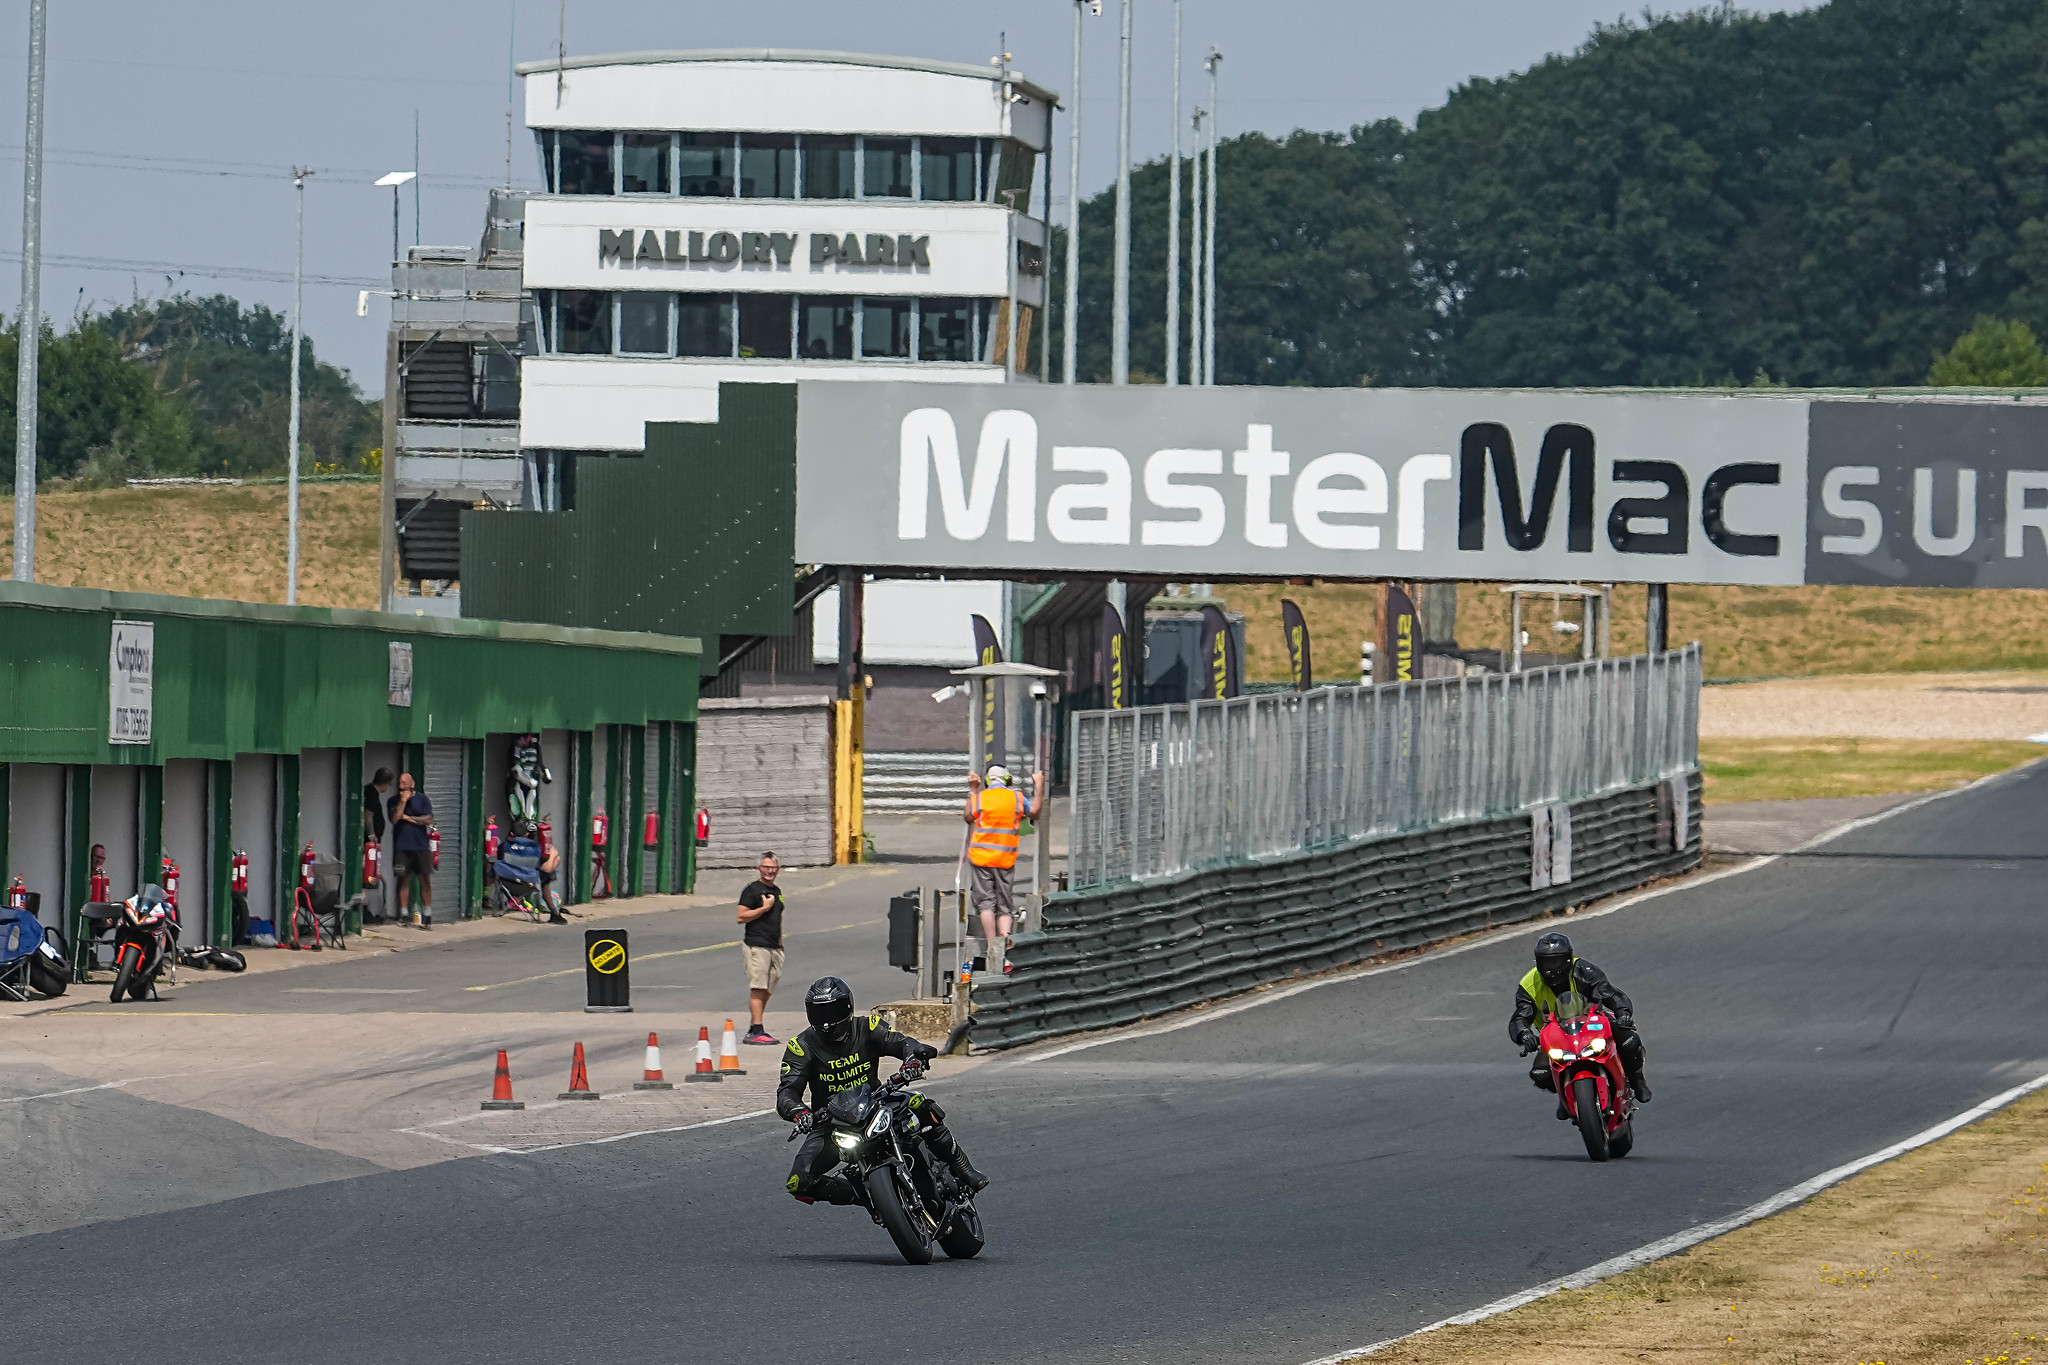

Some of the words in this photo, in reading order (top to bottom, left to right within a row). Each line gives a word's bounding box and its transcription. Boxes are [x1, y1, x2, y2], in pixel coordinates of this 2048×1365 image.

[599, 229, 798, 265] MALLORY
[809, 233, 931, 267] PARK
[827, 1052, 860, 1069] TEAM
[819, 1073, 835, 1082] NO
[837, 1061, 871, 1081] LIMITS
